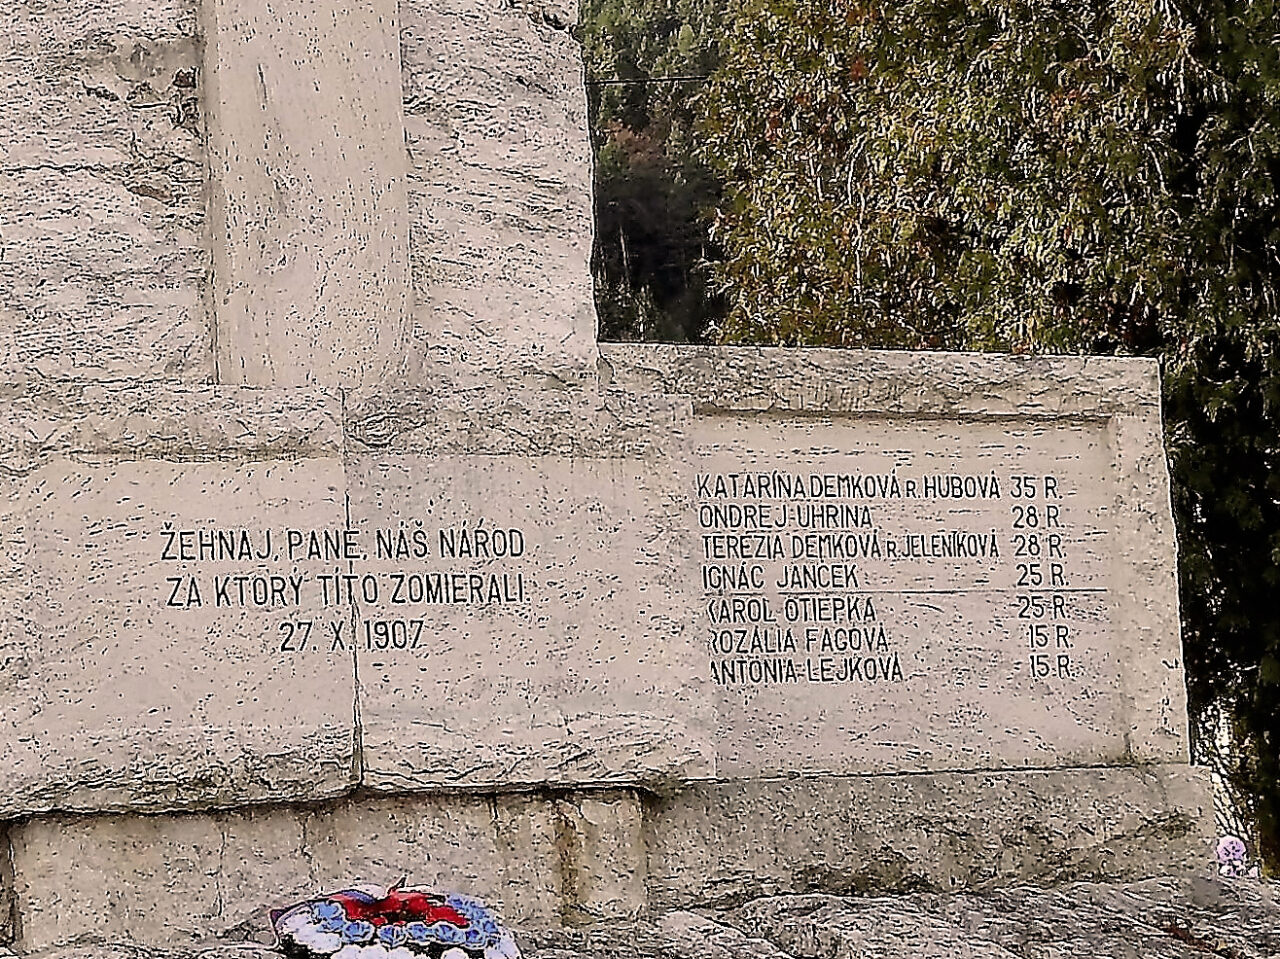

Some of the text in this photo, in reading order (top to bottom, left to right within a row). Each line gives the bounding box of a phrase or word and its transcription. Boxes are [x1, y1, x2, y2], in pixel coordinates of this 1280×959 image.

[696, 470, 806, 498] KATARÍNA
[809, 468, 901, 498] DEMKOVÁ
[923, 469, 1001, 498] HUBOVÁ
[1010, 476, 1036, 498] 35
[1044, 476, 1064, 499] R.
[699, 504, 1066, 528] ONDREJ UHRINA 28 R.
[160, 519, 524, 562] ŽEHNAJ, PANE, NÁŠ NÁROD
[792, 529, 881, 559] DEMKOVÁ
[1014, 534, 1040, 556] 28
[1049, 534, 1067, 558] R.
[166, 576, 202, 607] ZA
[214, 566, 303, 607] KTORÝ
[317, 566, 378, 606] TÍTO
[702, 560, 764, 589] IGNÁC
[1016, 563, 1042, 586] 25
[1051, 563, 1069, 586] R.
[785, 596, 876, 621] OTIEPKA
[1016, 596, 1044, 618] 25
[1052, 595, 1071, 619] R.
[279, 620, 317, 652] 27.
[363, 619, 424, 650] 1907
[806, 622, 889, 652] FAGOVÁ
[1029, 624, 1048, 648] 15
[1056, 625, 1074, 648] R.
[807, 651, 904, 681] LEJKOVÁ
[1030, 655, 1049, 678] 15
